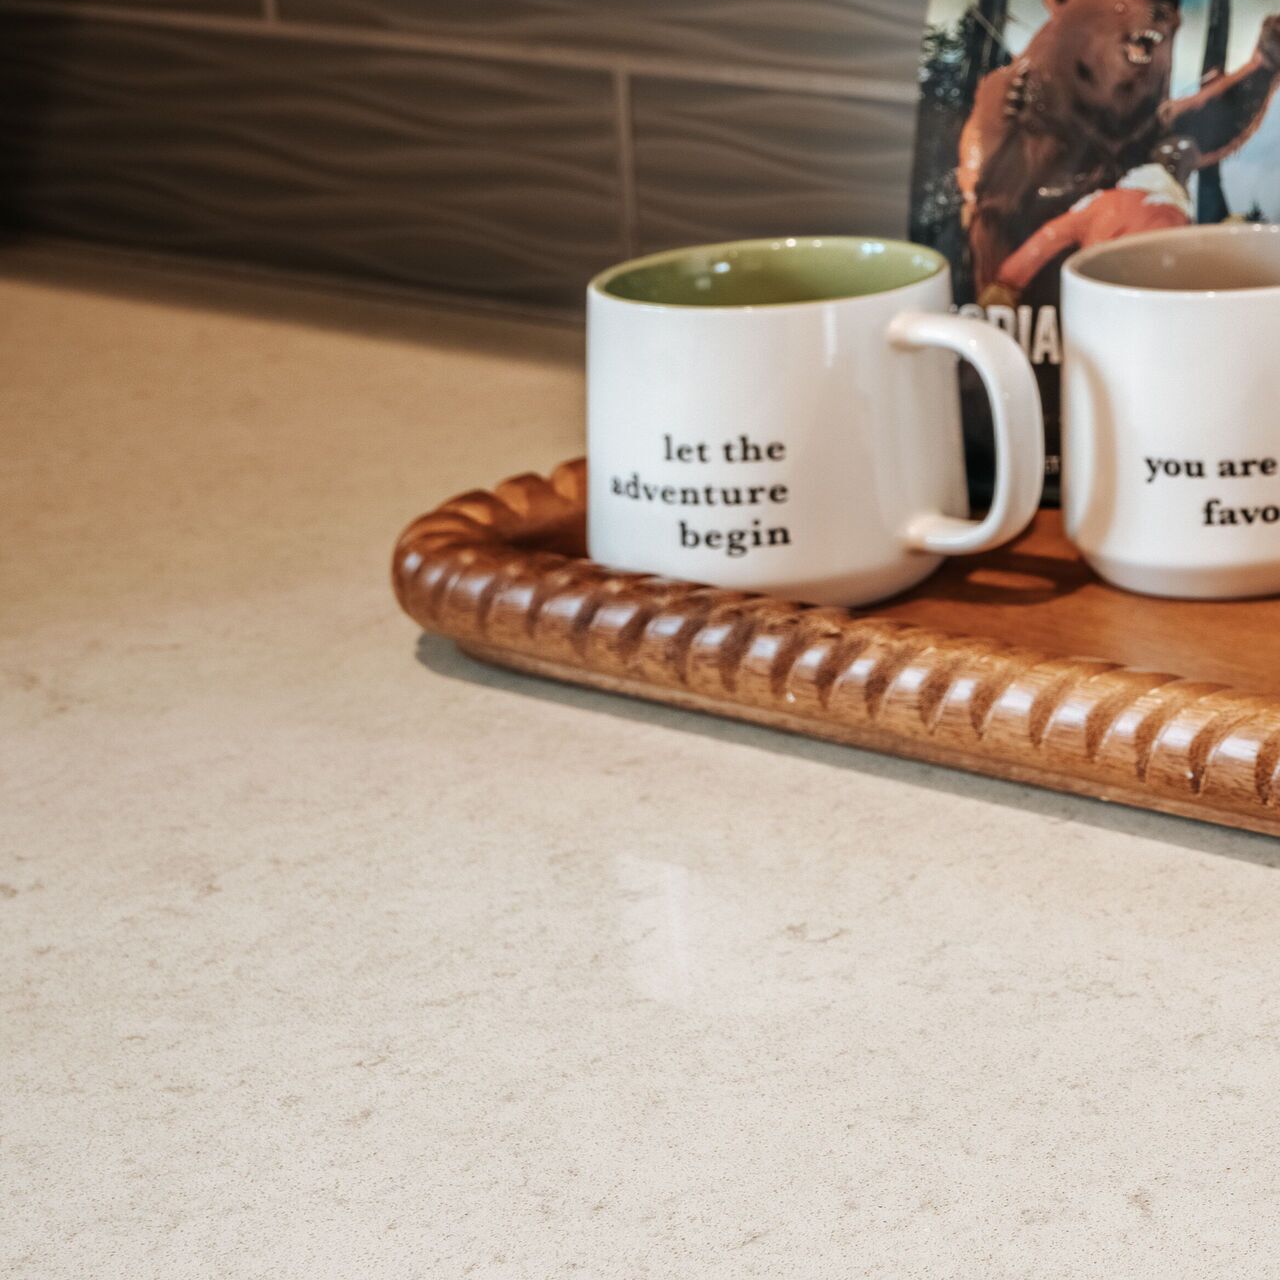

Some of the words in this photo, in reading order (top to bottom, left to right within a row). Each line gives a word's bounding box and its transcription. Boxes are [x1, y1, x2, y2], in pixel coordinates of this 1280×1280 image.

[663, 432, 711, 463] let
[722, 432, 786, 463] the
[1143, 455, 1206, 484] you
[1217, 456, 1278, 478] are
[610, 472, 790, 506] adventure
[678, 518, 792, 558] begin
